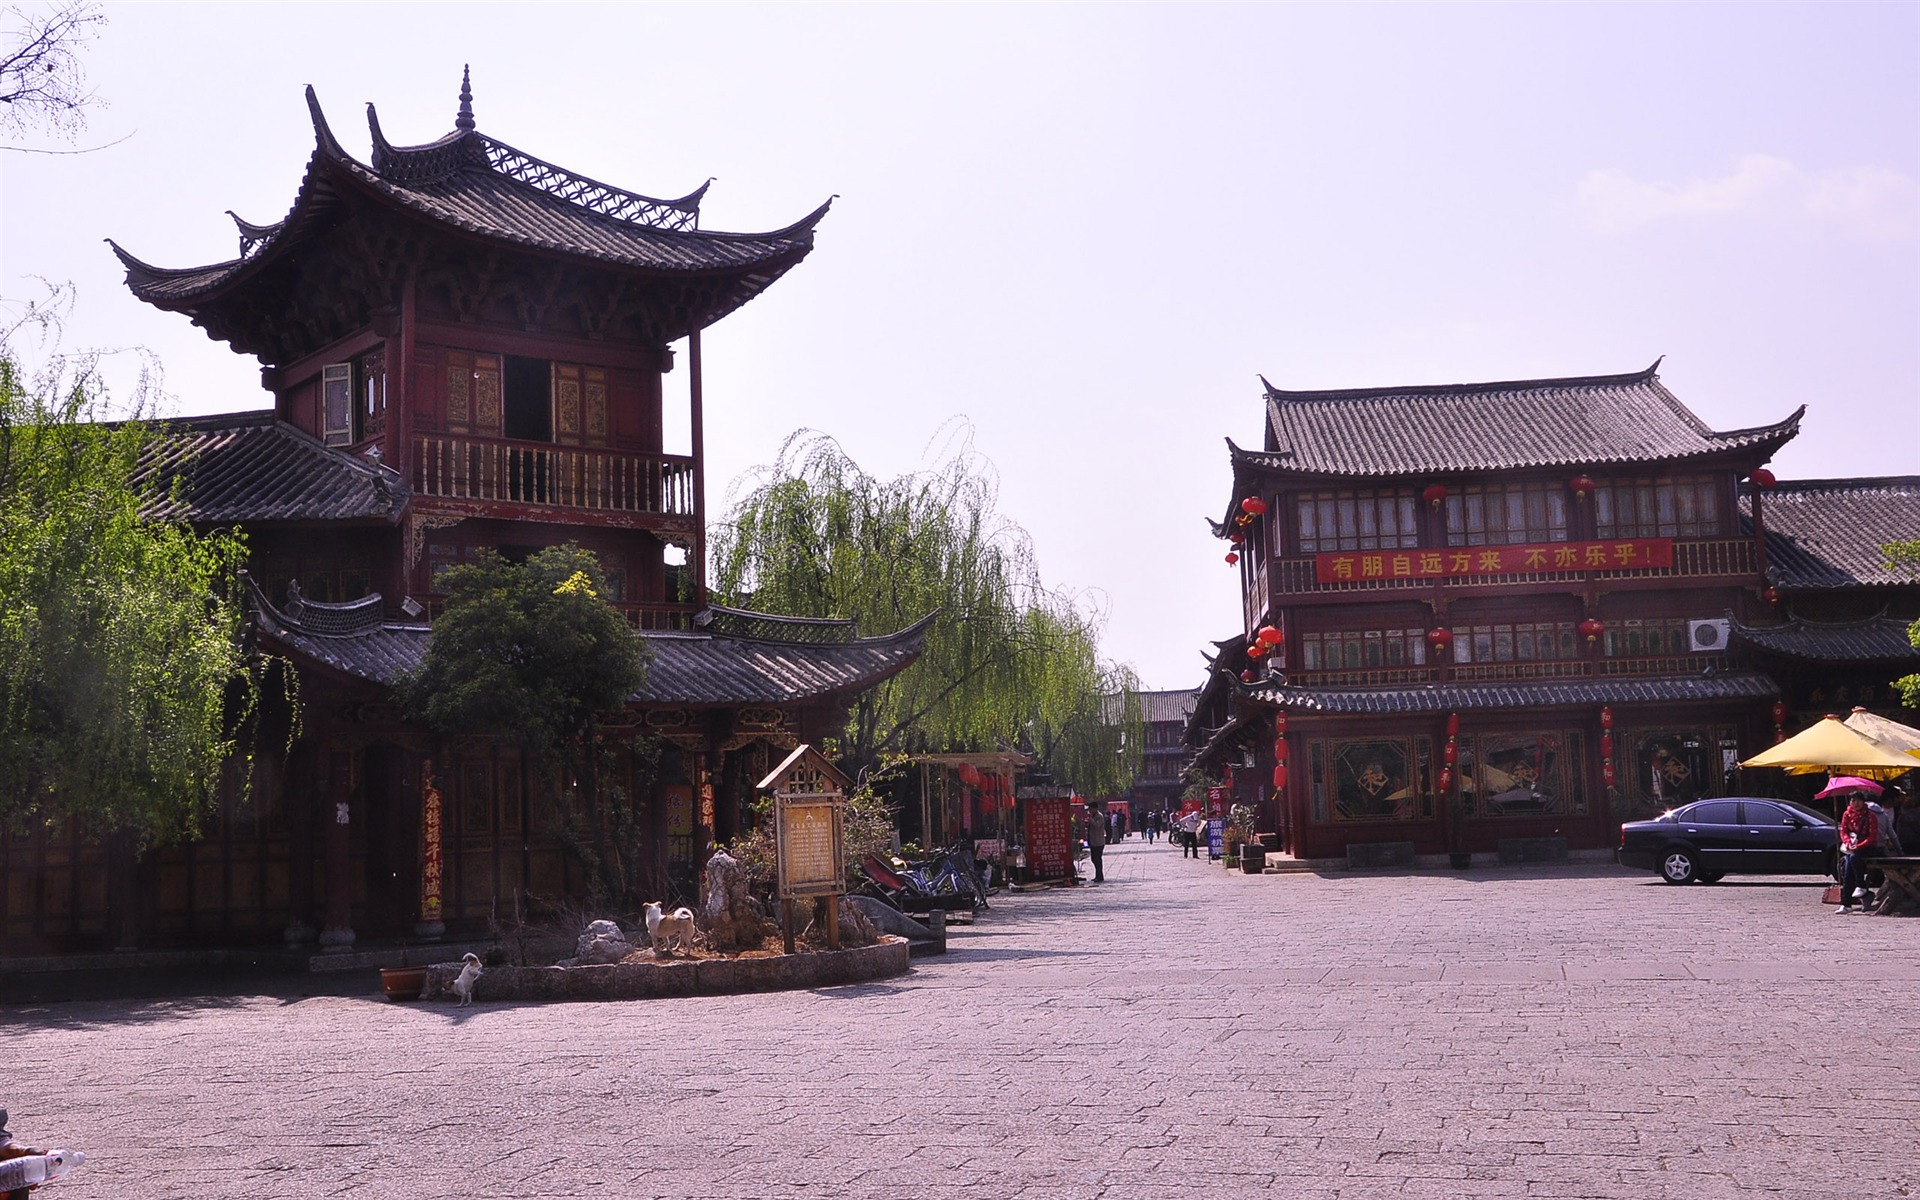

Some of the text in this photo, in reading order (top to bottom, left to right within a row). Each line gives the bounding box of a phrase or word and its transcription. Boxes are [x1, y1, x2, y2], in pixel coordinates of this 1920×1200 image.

[1332, 544, 1650, 578] 有朋自远方来 不亦乐乎！
